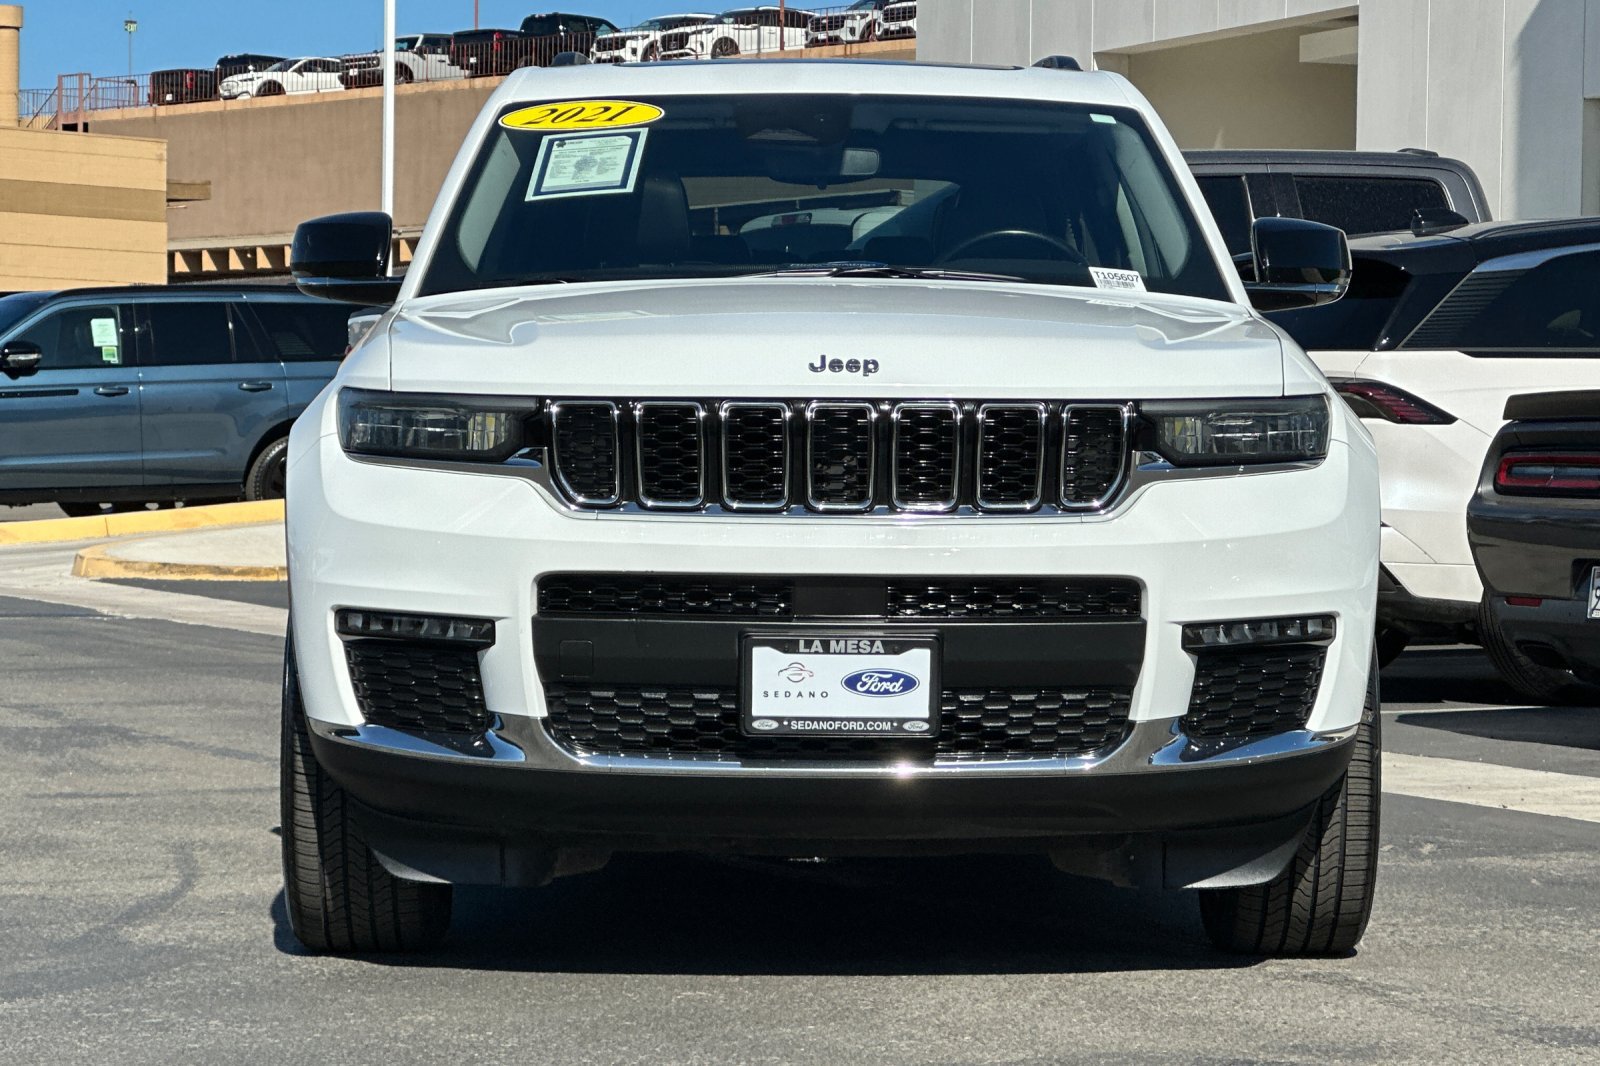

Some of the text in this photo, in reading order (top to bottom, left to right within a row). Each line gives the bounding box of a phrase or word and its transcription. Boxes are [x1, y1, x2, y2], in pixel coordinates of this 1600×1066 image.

[520, 105, 638, 126] 2021
[1093, 270, 1139, 283] T105607
[808, 354, 880, 377] Jeep
[798, 639, 885, 654] LA MESA
[856, 672, 904, 693] Ford
[763, 690, 829, 698] SEDANO
[756, 721, 774, 730] Ford
[790, 720, 892, 731] SEDANOFORD.COM
[907, 722, 925, 731] Ford
